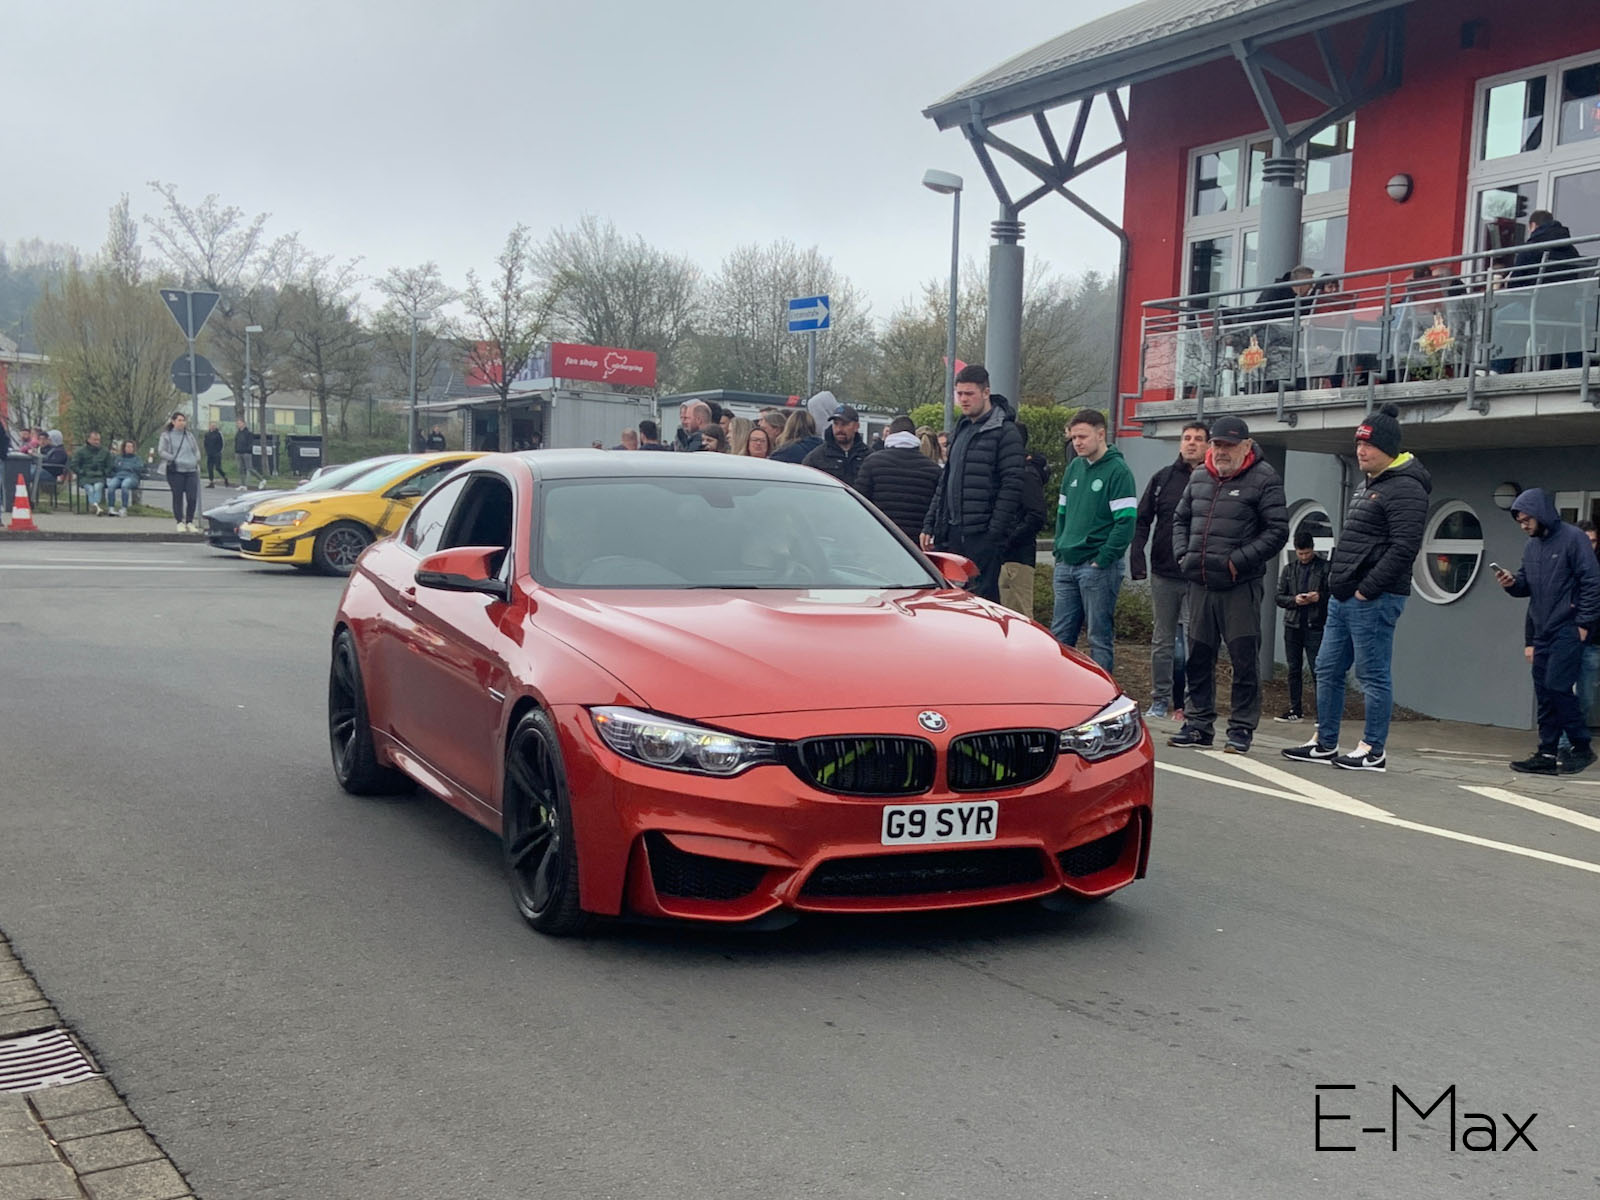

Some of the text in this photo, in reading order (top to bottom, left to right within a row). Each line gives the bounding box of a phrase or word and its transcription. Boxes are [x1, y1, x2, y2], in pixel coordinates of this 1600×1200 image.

[565, 356, 598, 368] fan shop
[887, 806, 993, 838] G9 SYR
